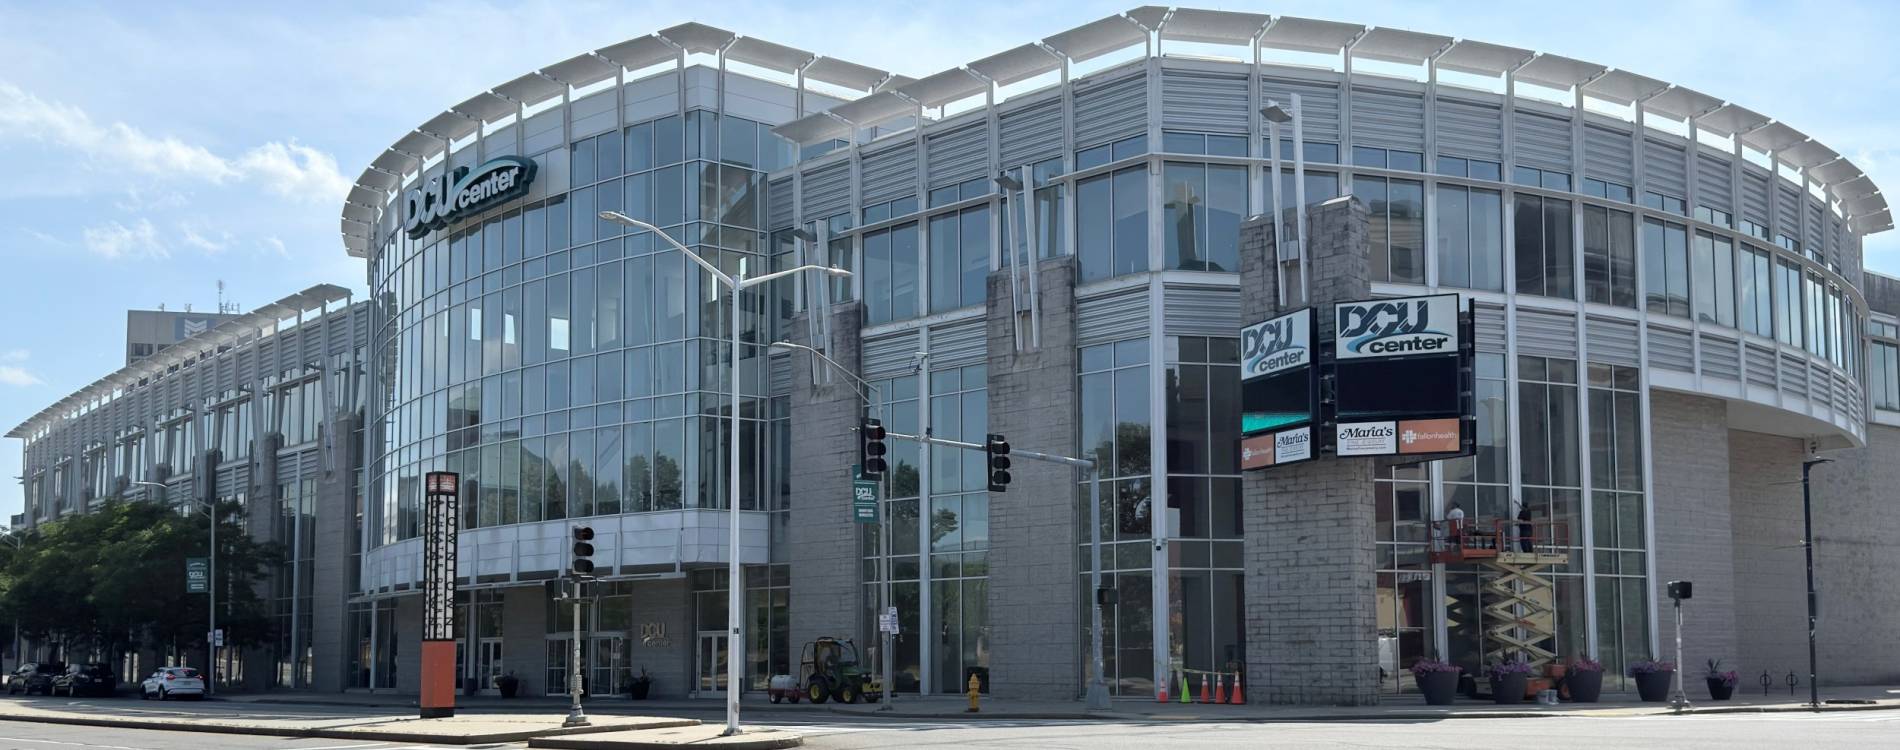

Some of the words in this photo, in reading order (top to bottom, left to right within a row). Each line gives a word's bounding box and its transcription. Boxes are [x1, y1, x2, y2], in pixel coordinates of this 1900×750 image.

[459, 166, 519, 208] center
[403, 170, 456, 232] DCU
[1340, 300, 1428, 338] DCU
[1243, 317, 1293, 361] DCU
[1369, 336, 1448, 353] center
[1259, 350, 1304, 372] center
[1277, 433, 1309, 448] Maria's
[1340, 426, 1393, 440] Maria's
[855, 487, 872, 496] DCU
[640, 623, 665, 638] DCU
